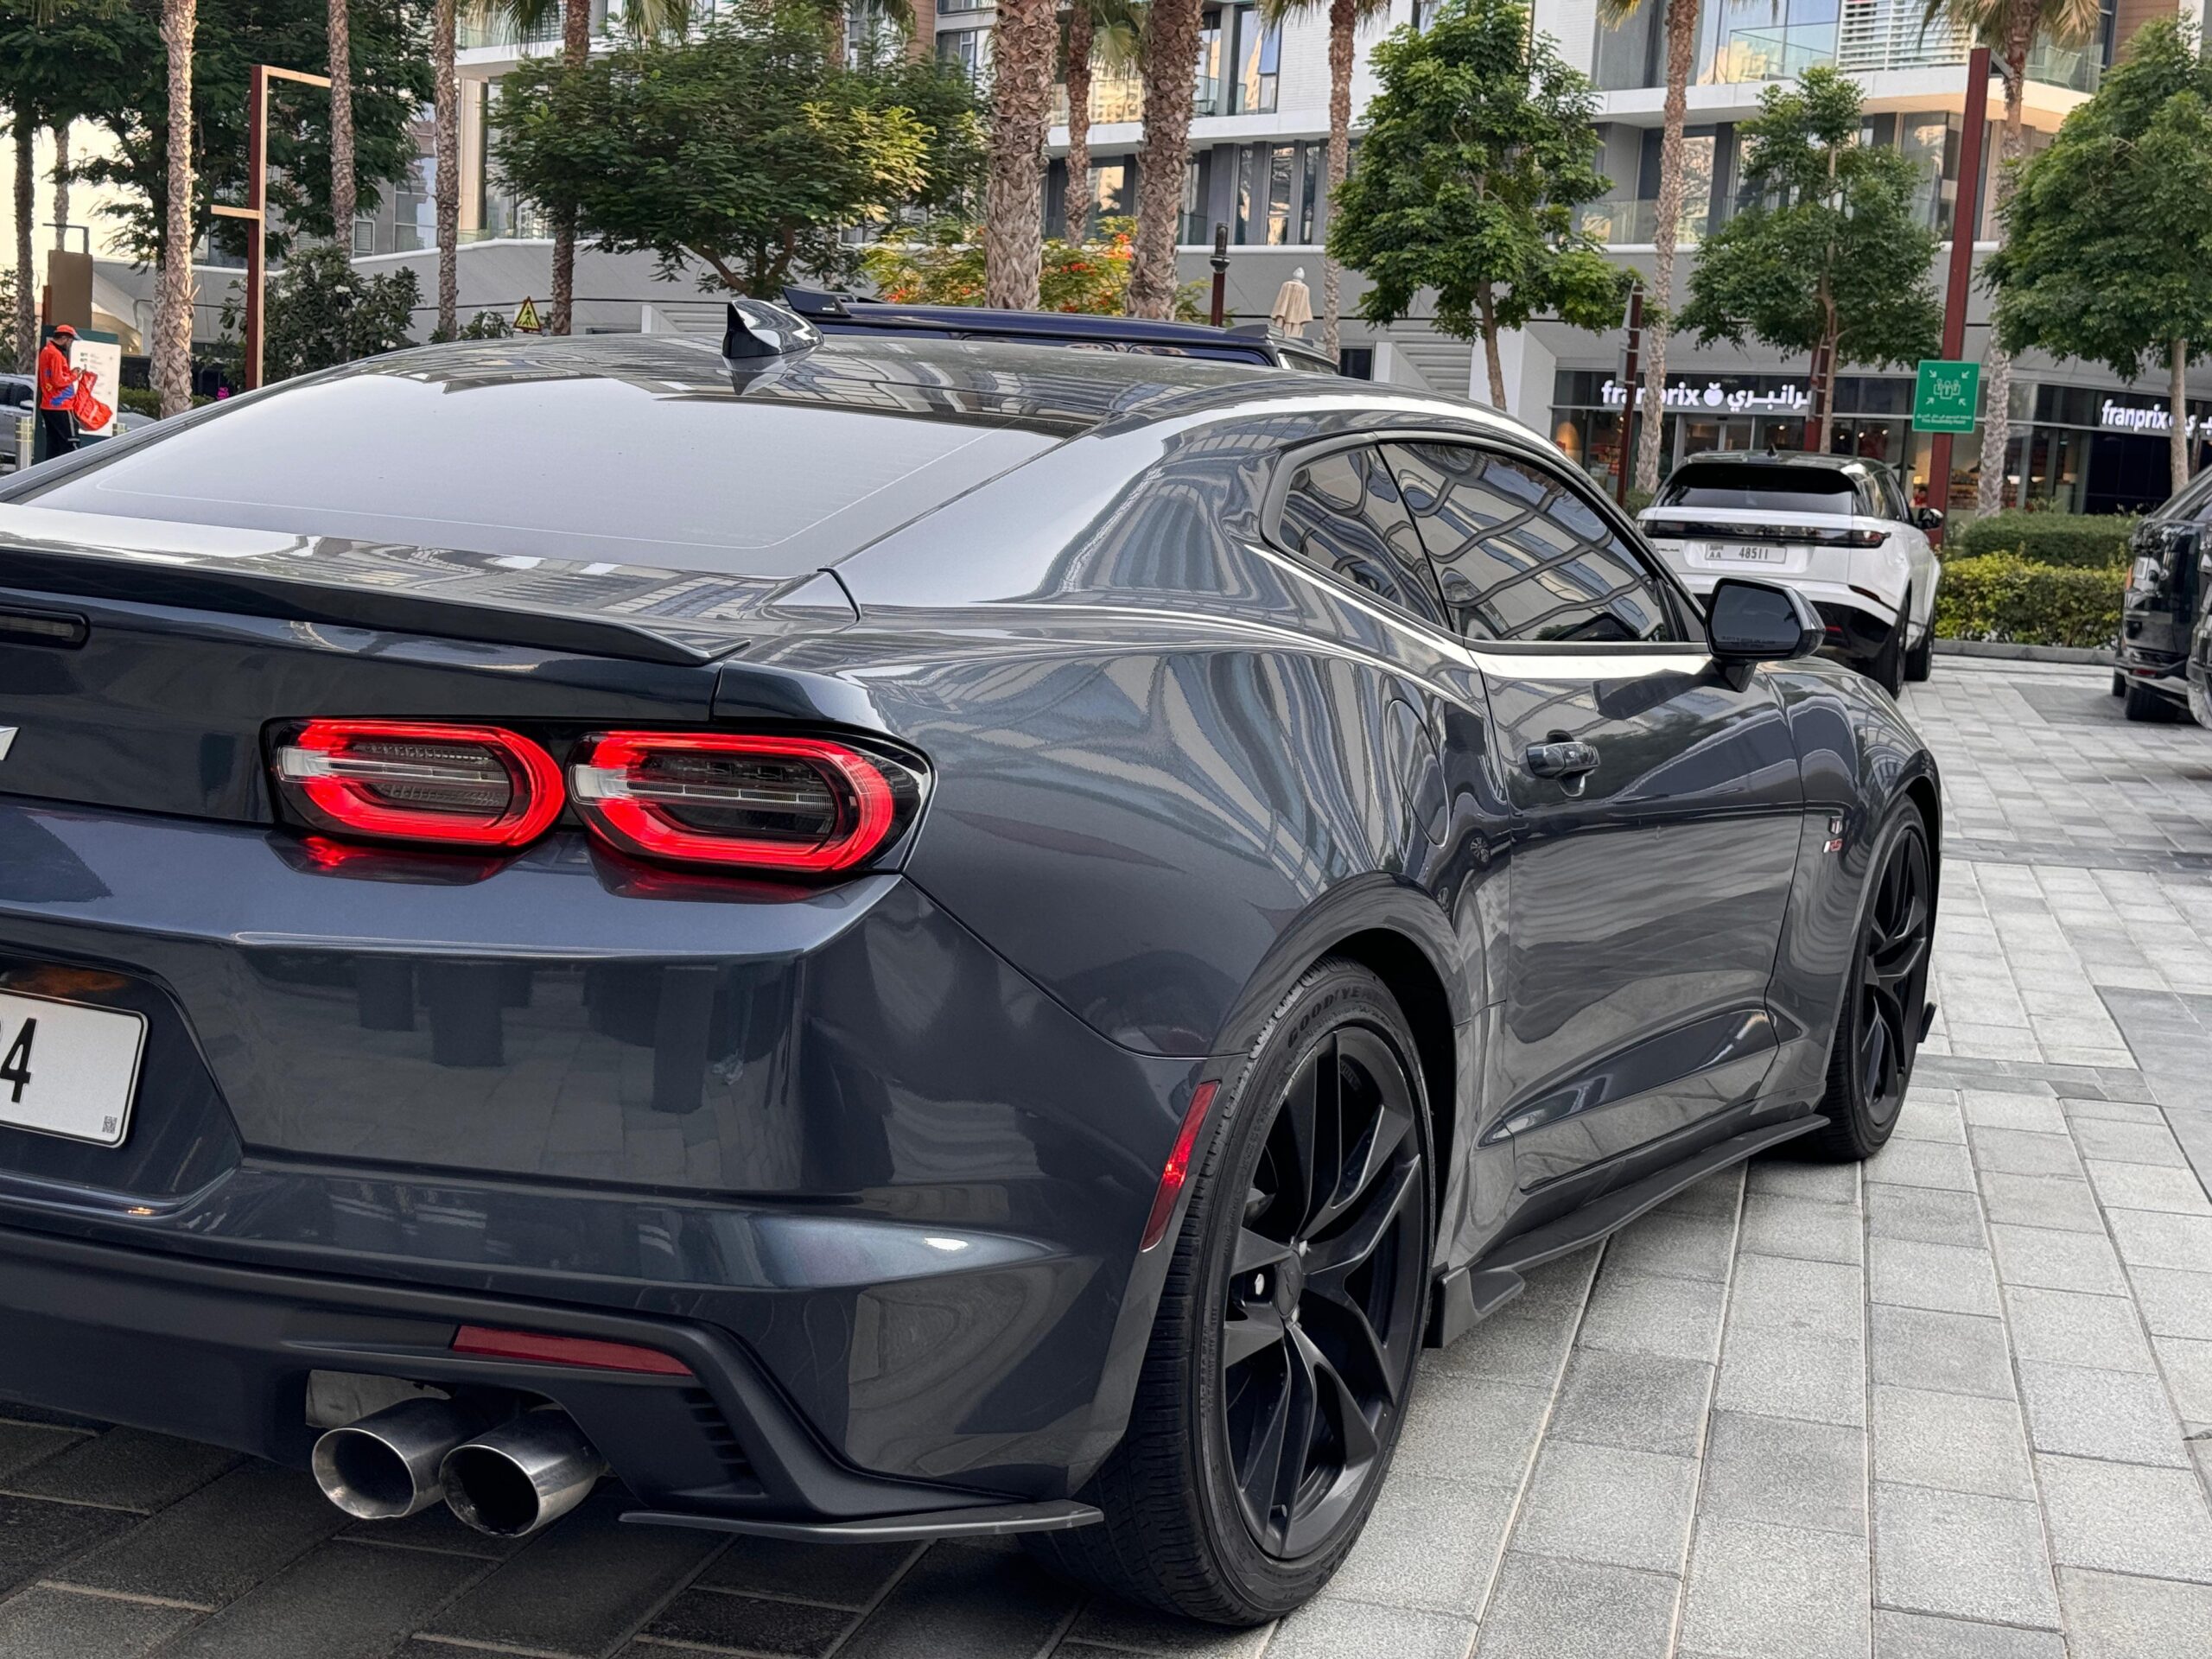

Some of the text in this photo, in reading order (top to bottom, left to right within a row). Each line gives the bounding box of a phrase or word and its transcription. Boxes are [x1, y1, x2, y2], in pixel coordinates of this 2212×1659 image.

[2101, 399, 2169, 432] franprix
[1738, 547, 1768, 560] 48511
[0, 1017, 37, 1103] 4
